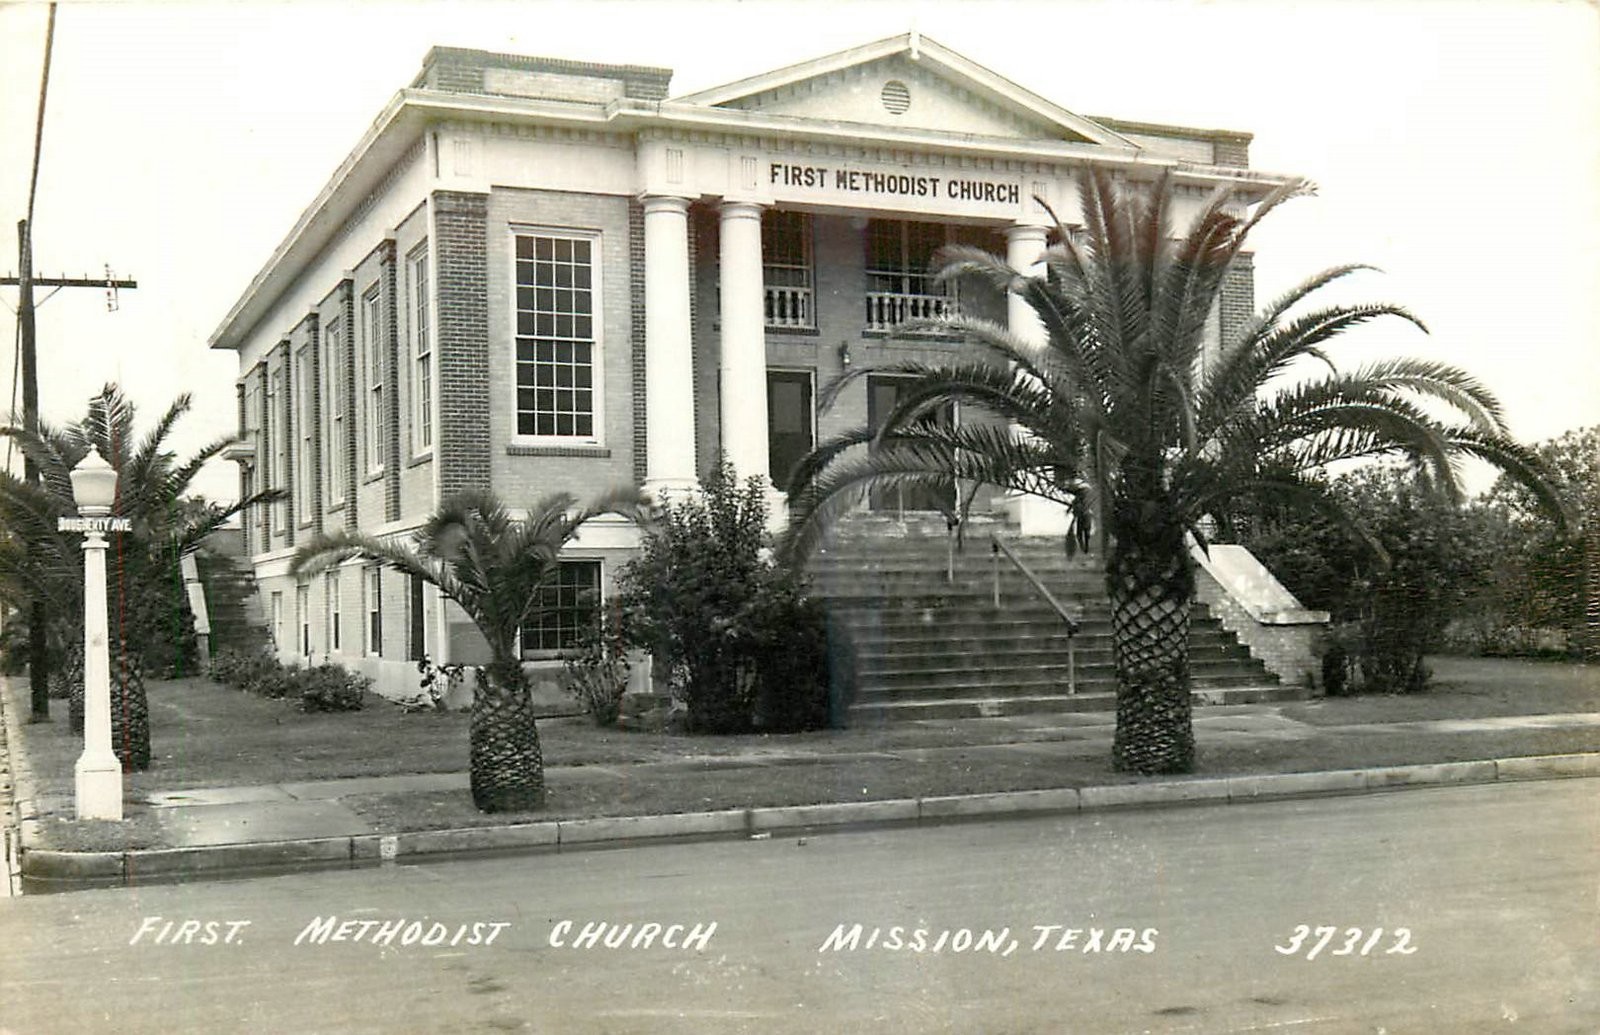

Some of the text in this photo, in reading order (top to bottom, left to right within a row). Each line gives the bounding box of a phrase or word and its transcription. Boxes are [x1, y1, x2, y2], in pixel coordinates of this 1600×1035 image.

[770, 163, 1019, 205] FIRST METHODIST CHURCH
